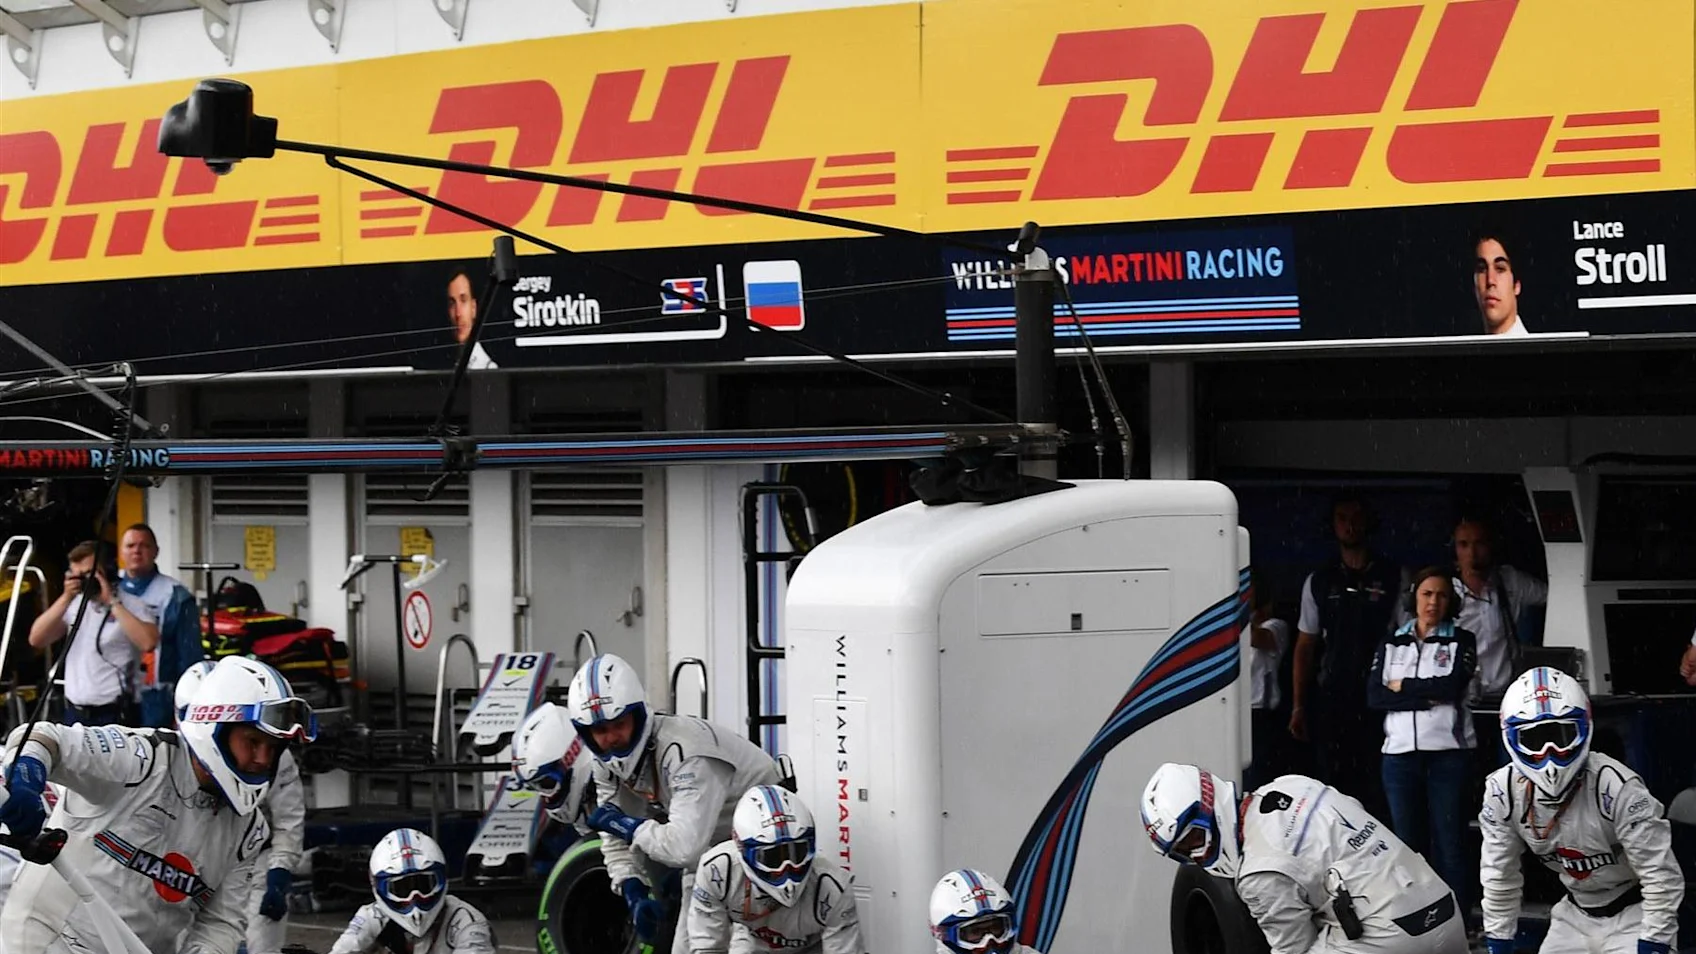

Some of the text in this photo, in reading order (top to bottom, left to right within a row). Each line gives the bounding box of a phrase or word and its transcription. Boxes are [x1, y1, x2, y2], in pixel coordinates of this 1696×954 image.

[1030, 0, 1554, 201] DHL
[425, 55, 816, 234] DHL
[1573, 220, 1624, 240] Lance
[951, 246, 1284, 290] WILLIS MARTINI RACING
[1574, 244, 1667, 285] Stroll
[513, 293, 600, 328] Sirotkin
[90, 447, 170, 467] RAING
[505, 654, 538, 671] 18
[836, 634, 851, 871] WILLIAMS MARTI
[1346, 820, 1378, 851] Rexona
